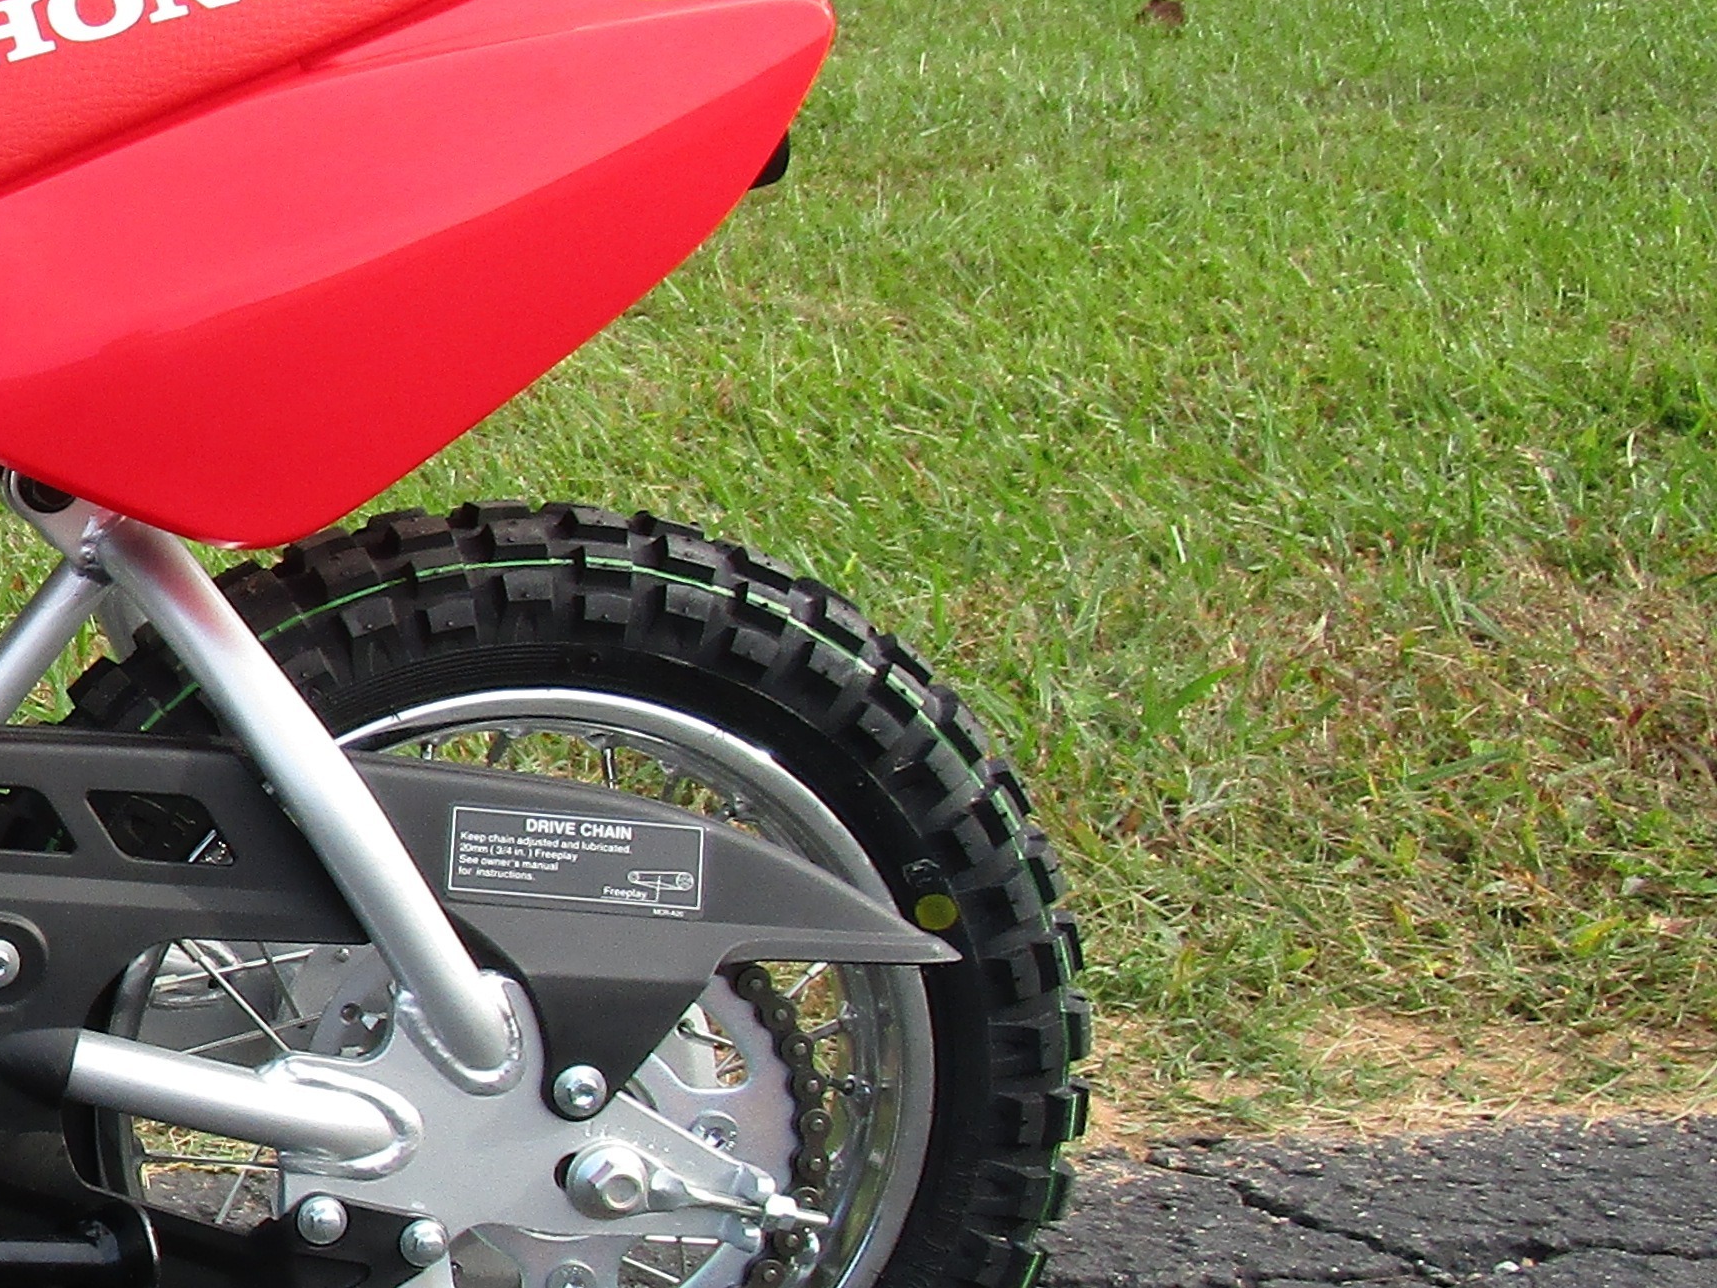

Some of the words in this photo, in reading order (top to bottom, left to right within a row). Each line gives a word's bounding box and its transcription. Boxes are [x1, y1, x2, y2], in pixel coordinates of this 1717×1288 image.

[525, 818, 576, 836] DRIVE
[580, 822, 633, 841] CHAIN
[459, 831, 487, 844] Keep
[488, 833, 515, 844] chain
[516, 836, 559, 849] adjusted
[560, 840, 580, 850] and
[458, 853, 479, 865] See
[521, 861, 559, 872] manual
[534, 848, 579, 863] Freeplay
[458, 865, 473, 876] for
[602, 885, 648, 901] Freeplay
